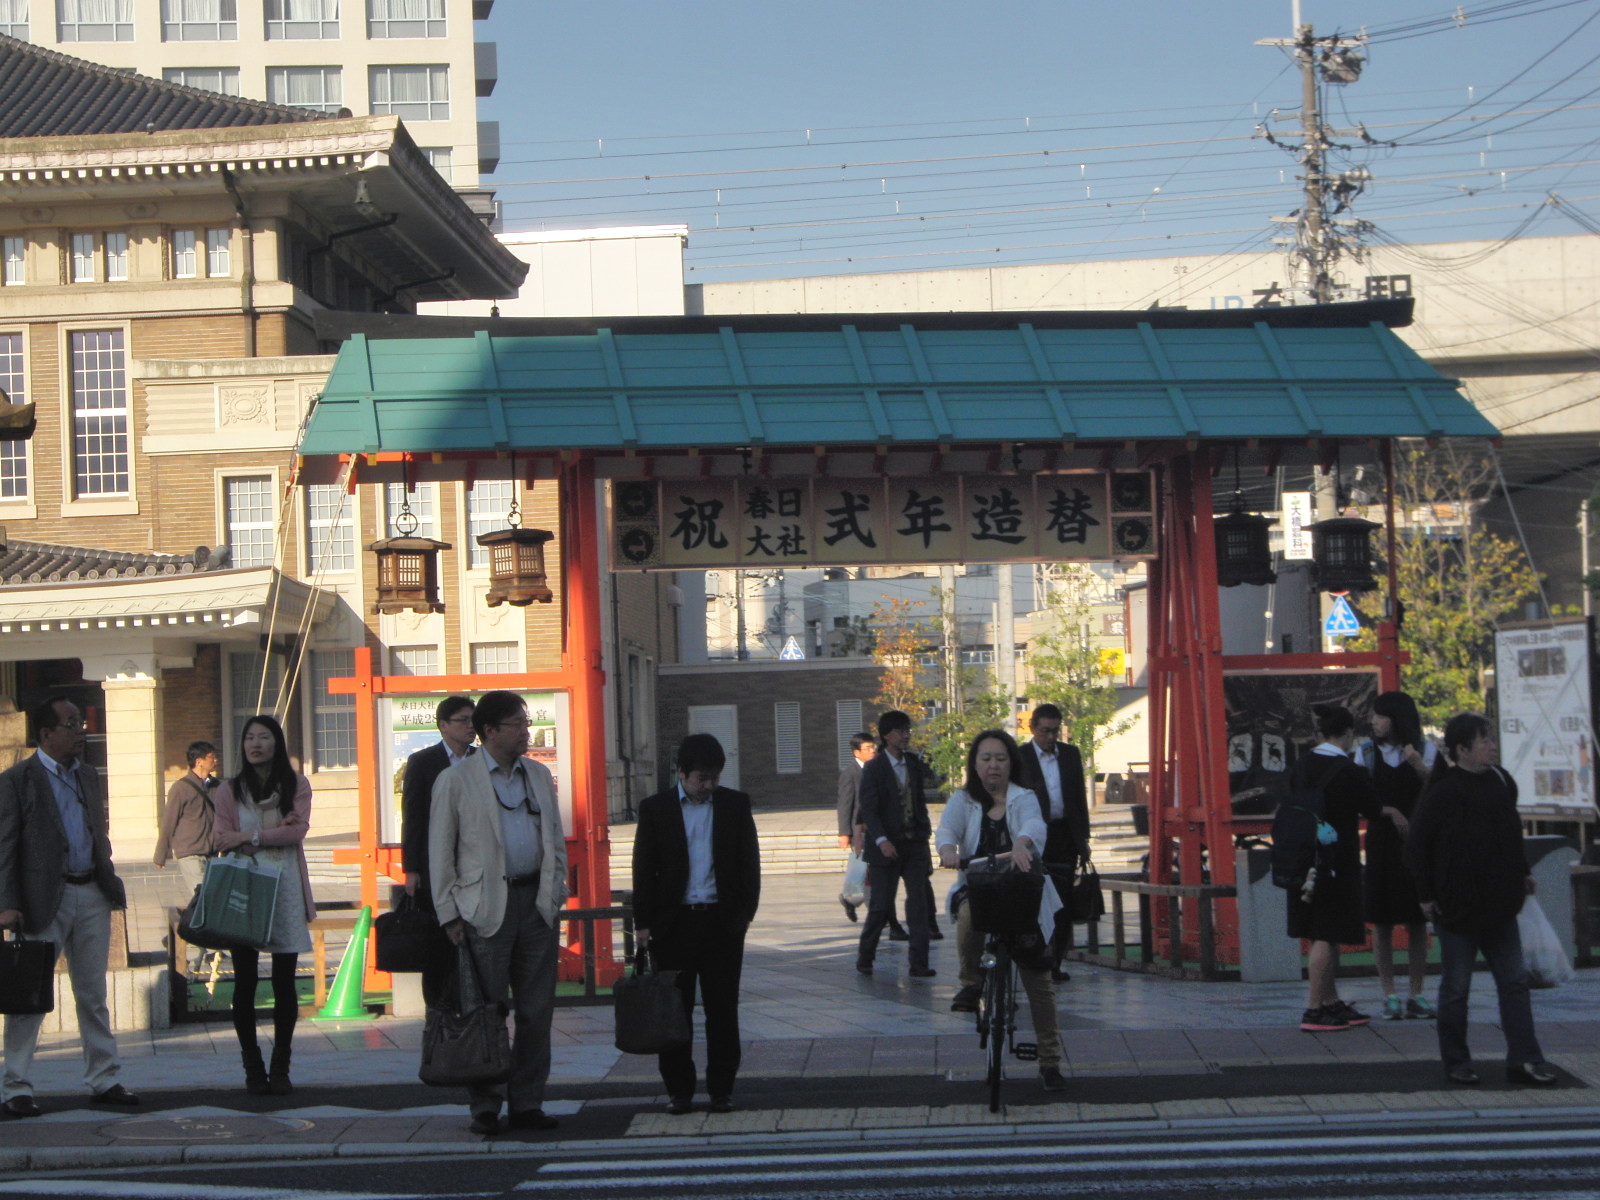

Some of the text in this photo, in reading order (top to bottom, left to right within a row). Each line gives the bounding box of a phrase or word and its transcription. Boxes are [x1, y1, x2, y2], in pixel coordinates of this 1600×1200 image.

[670, 495, 729, 550] 祝
[400, 700, 436, 711] 春日大社
